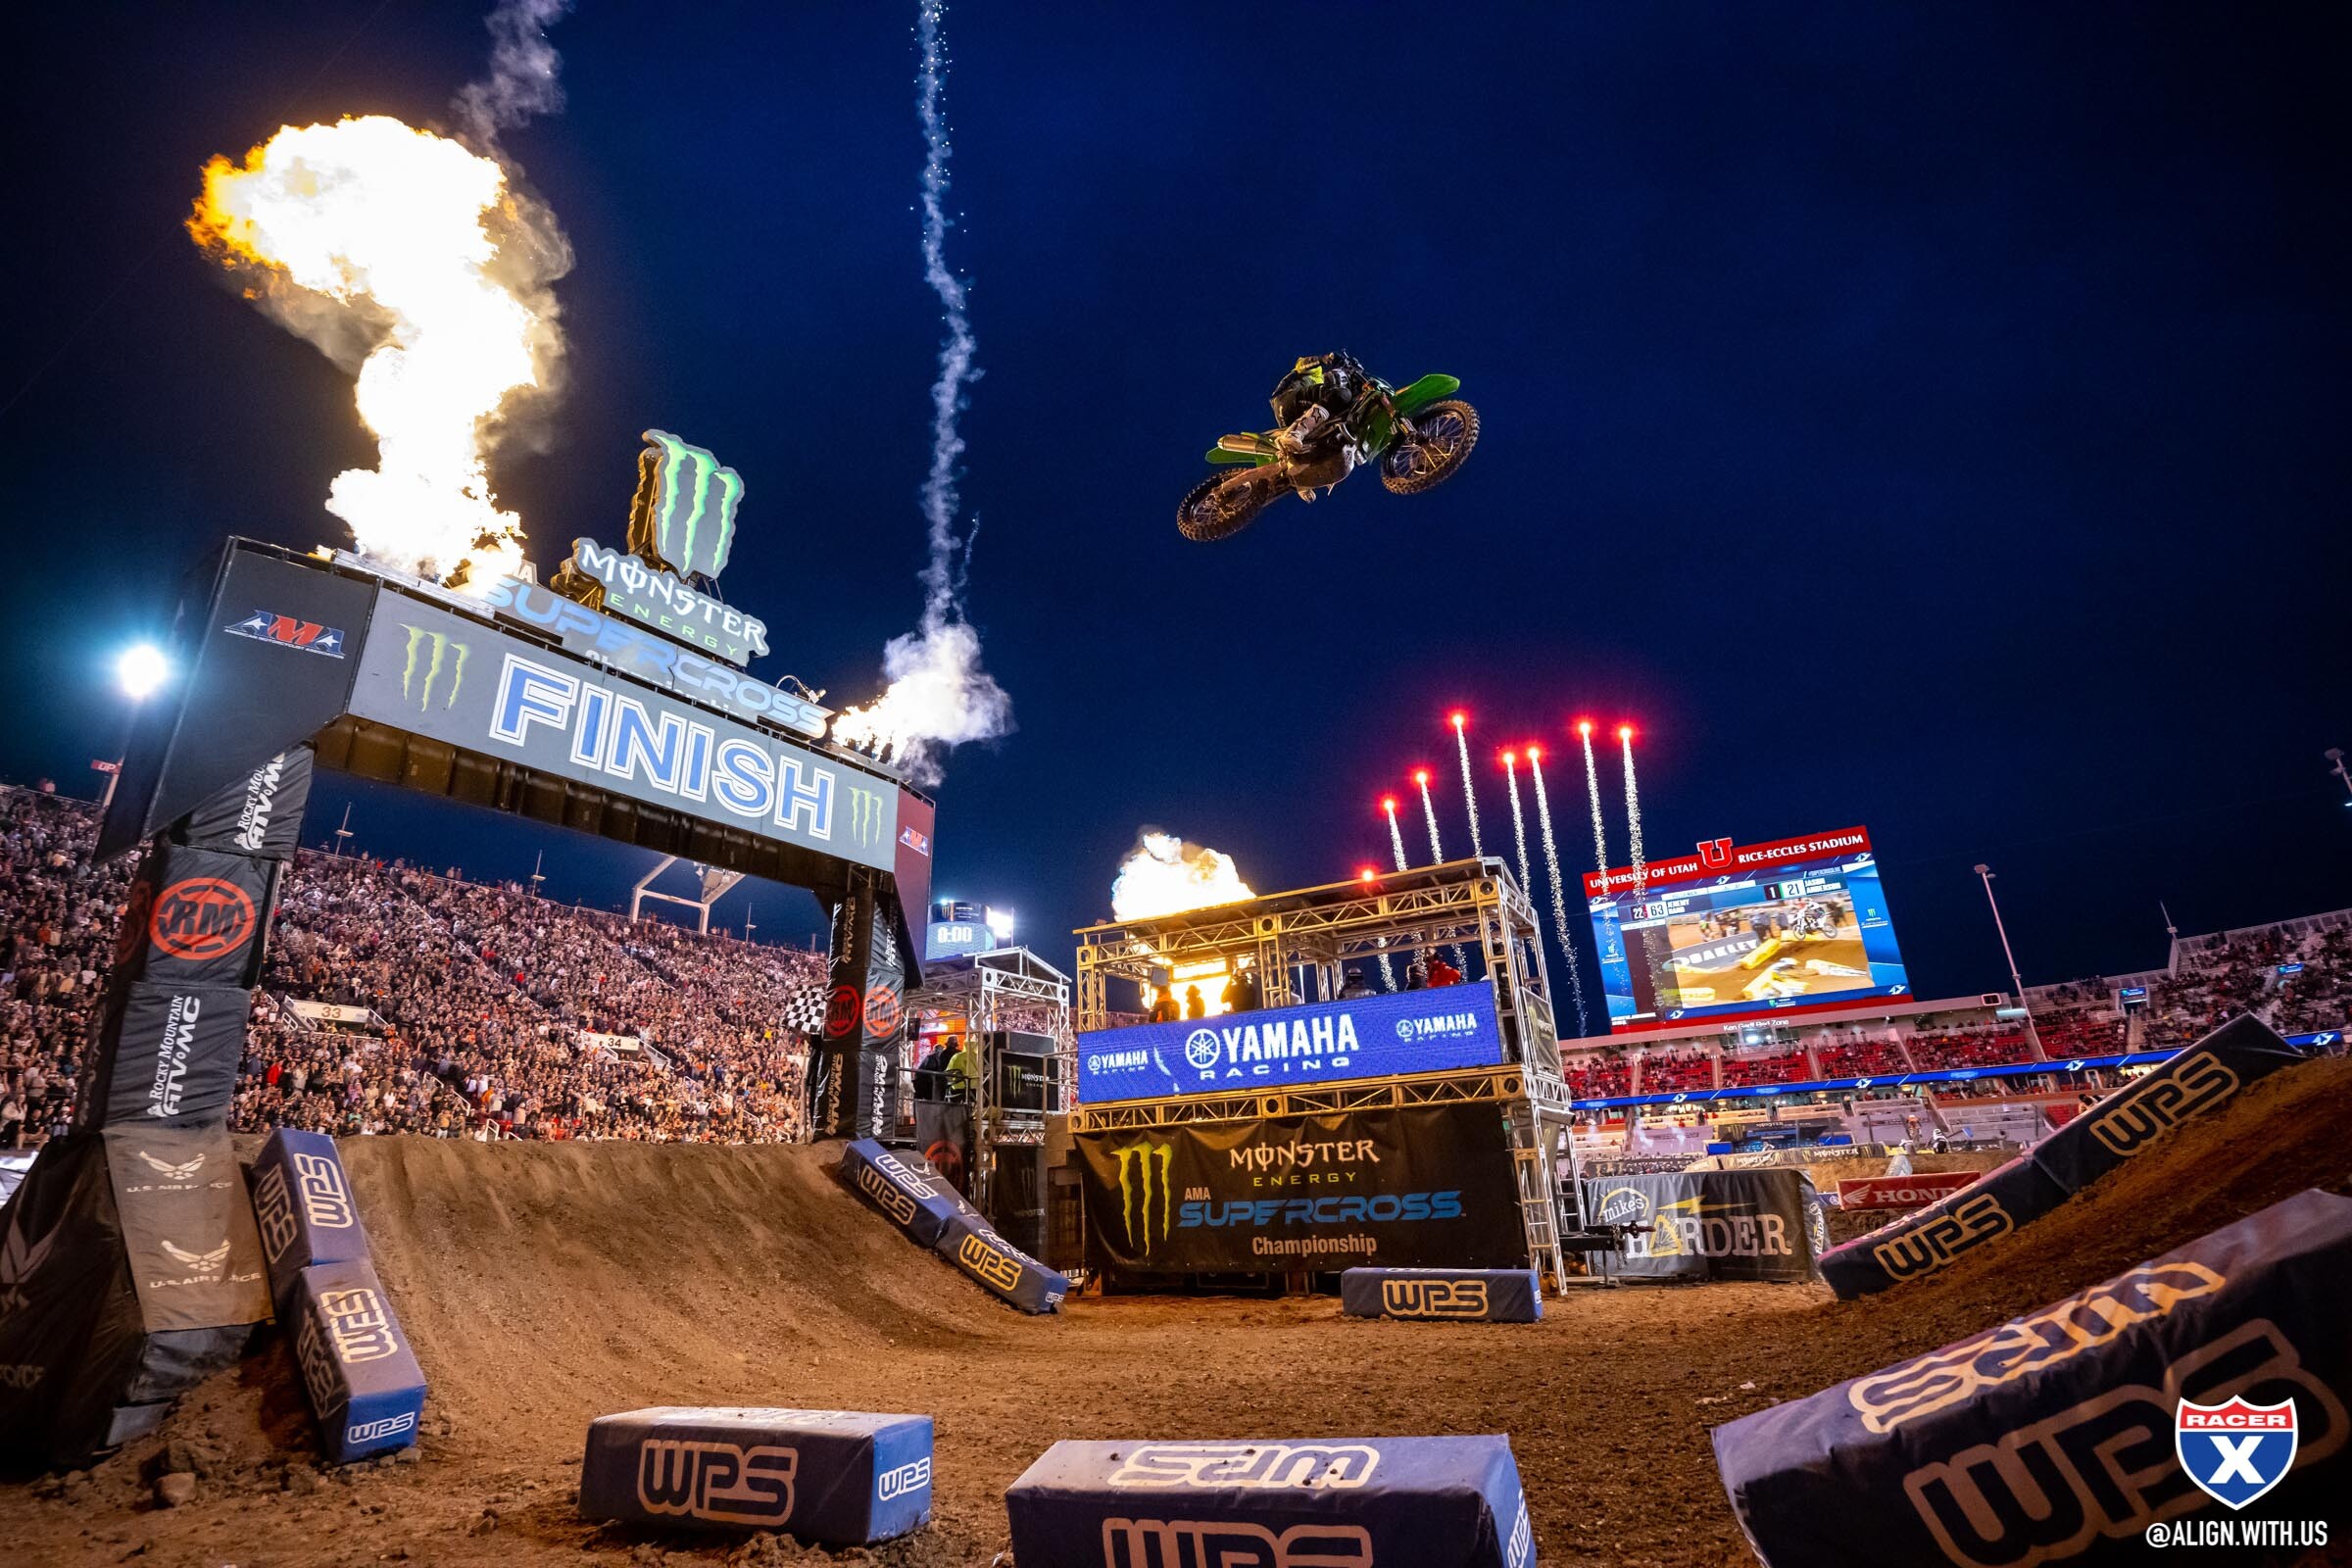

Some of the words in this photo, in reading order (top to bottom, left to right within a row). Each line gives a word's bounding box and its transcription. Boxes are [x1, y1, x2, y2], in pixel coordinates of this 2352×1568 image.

[582, 543, 765, 652] MONSTER
[223, 609, 346, 656] AMA
[610, 593, 739, 657] ENERGY
[480, 577, 836, 739] SUPERCROSS
[489, 652, 835, 841] FINISH
[237, 795, 258, 831] ROCKY
[1696, 837, 1734, 869] U
[1738, 844, 1807, 863] RICE-ECCLES
[1809, 834, 1864, 852] STADIUM
[1651, 867, 1666, 877] OF
[1668, 862, 1698, 875] UTAH
[1769, 886, 1776, 899] 1
[1787, 884, 1800, 896] 21
[170, 900, 239, 938] RM
[1633, 907, 1643, 919] 22
[1650, 904, 1664, 916] 63
[938, 926, 972, 943] 0:00
[158, 996, 184, 1059] MOUNTAIN
[321, 1006, 341, 1018] 33
[1415, 1012, 1477, 1034] YAMAHA
[1723, 1023, 1738, 1032] Ken
[608, 1038, 621, 1047] 34
[1222, 1013, 1360, 1063] YAMAHA
[1102, 1050, 1149, 1068] YAMAHA
[1200, 1056, 1351, 1081] RACING
[149, 1060, 170, 1100] ROCKY
[2088, 1051, 2240, 1156] WPS
[1230, 1139, 1381, 1172] MONSTER
[294, 1152, 354, 1229] WPS
[860, 1164, 917, 1225] WPS
[875, 1153, 939, 1200] WPS
[1185, 1187, 1211, 1200] AMA
[1253, 1172, 1357, 1188] ENERGY
[1177, 1191, 1463, 1228] SUPERCROSS
[1603, 1195, 1645, 1223] mike's
[1251, 1234, 1378, 1257] Championship
[1624, 1213, 1792, 1259] HARDER
[1873, 1193, 2014, 1282] WPS
[183, 1275, 211, 1285] AIR
[959, 1233, 1023, 1292] WPS
[1383, 1280, 1490, 1317] WPS
[348, 1411, 416, 1444] WPS
[638, 1439, 799, 1527] WPS
[878, 1456, 930, 1501] WPS
[1107, 1445, 1380, 1489] WPS
